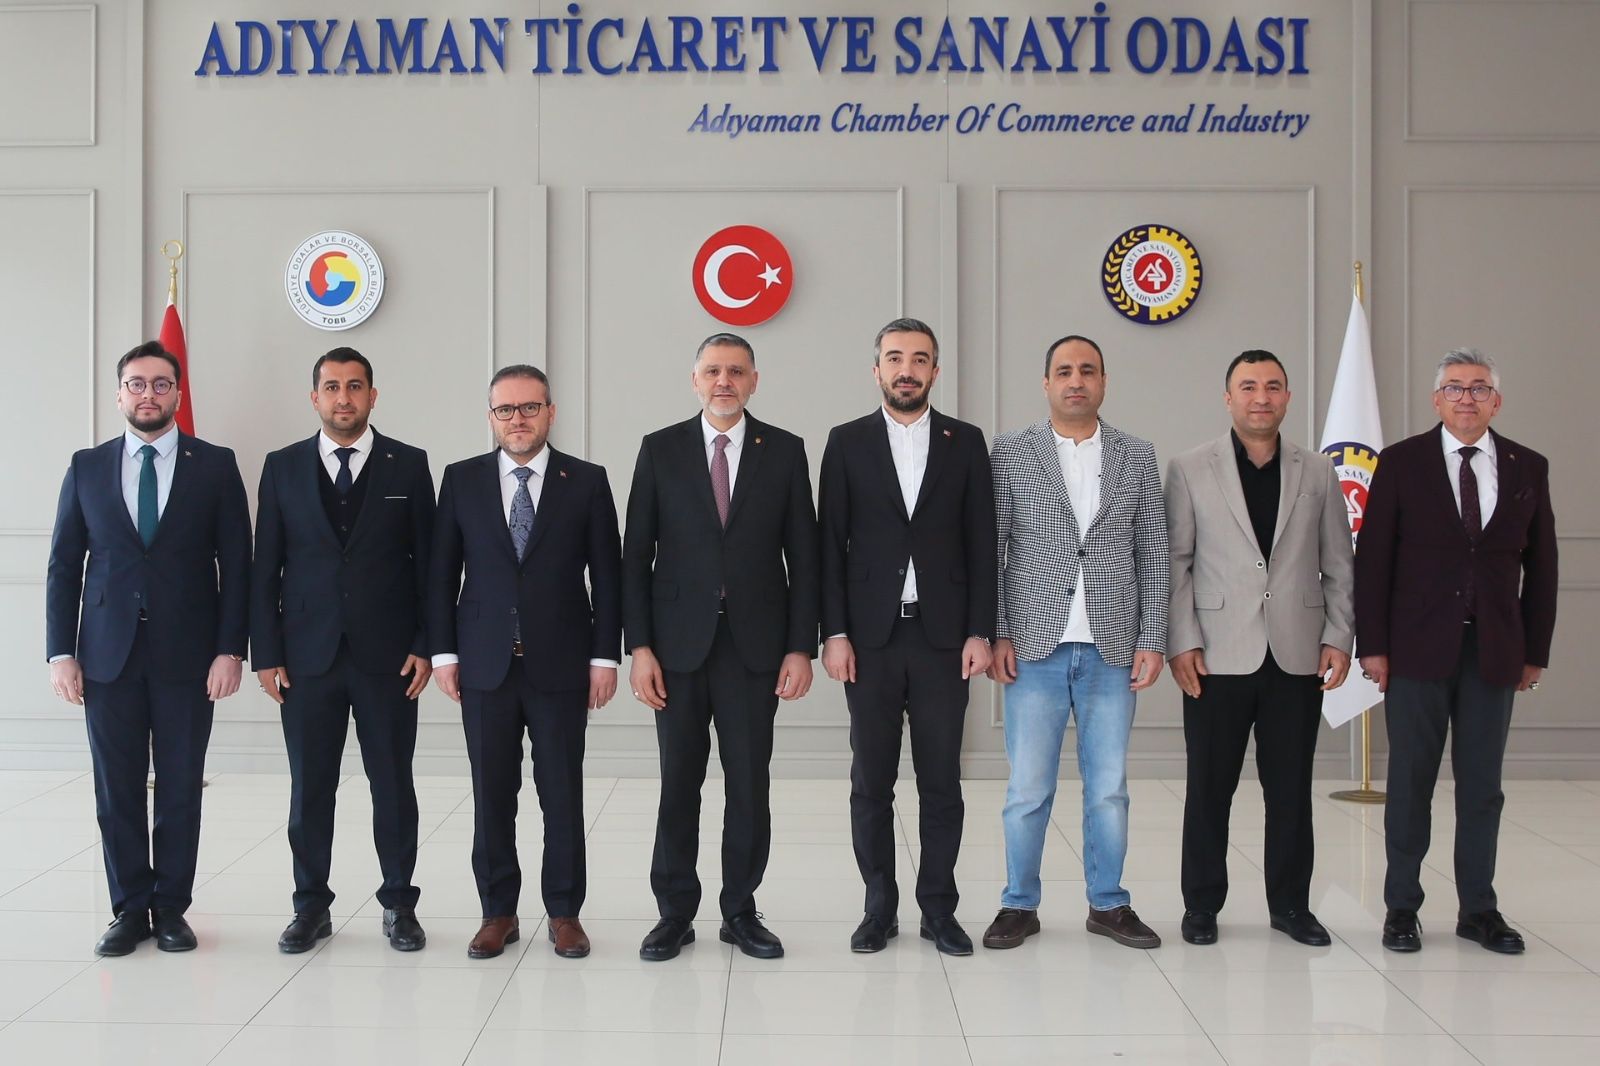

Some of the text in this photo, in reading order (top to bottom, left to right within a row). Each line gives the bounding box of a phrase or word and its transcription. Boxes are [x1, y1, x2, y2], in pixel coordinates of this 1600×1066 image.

[194, 2, 1310, 77] ADIYAMAN TİCARET VE SANAYİ ODASI
[688, 102, 1310, 139] Adıyaman Chamber Of Commerce and Industry
[293, 240, 321, 270] ODALAR
[341, 237, 377, 276] BORSALAR
[1344, 469, 1369, 485] SANA
